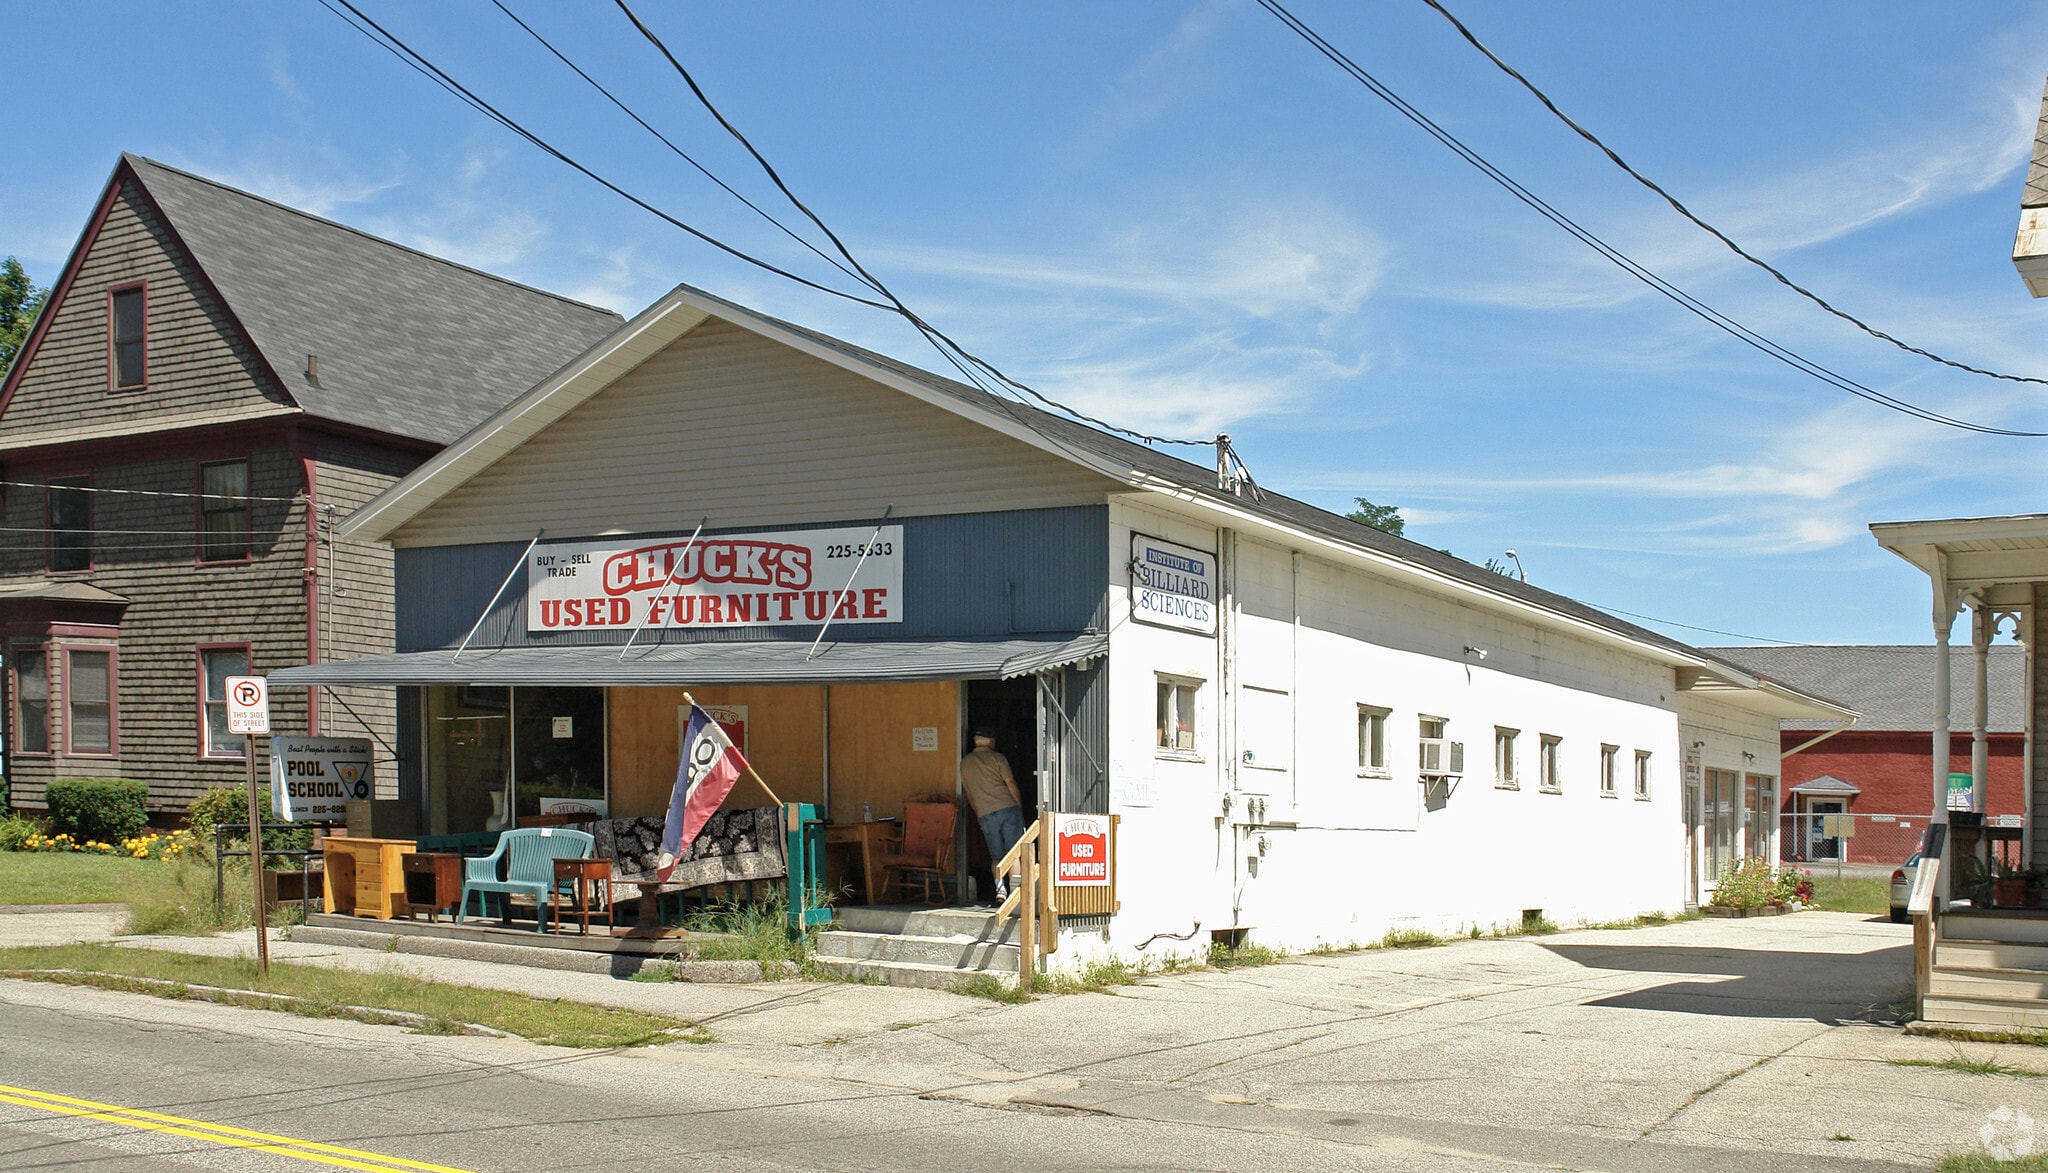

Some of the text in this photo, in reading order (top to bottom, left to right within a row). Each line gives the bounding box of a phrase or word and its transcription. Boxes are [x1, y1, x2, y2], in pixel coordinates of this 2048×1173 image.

[826, 542, 892, 559] 225-5533
[536, 555, 556, 566] BUY
[571, 554, 592, 566] SELL
[604, 540, 811, 594] CHUCK'S
[1148, 550, 1203, 574] INSTITUTE OF
[546, 566, 578, 578] TRADE
[1142, 567, 1209, 600] BILLIARD
[540, 598, 631, 628] USED
[647, 588, 888, 624] FURNITURE
[1142, 590, 1209, 622] SCIENCES
[288, 760, 325, 776] POOL
[288, 782, 343, 798] SCHOOL
[552, 804, 595, 814] CHUCK'
[1064, 820, 1100, 836] CHUCK'S
[1072, 843, 1094, 858] USED
[1060, 862, 1105, 877] FURNITURE
